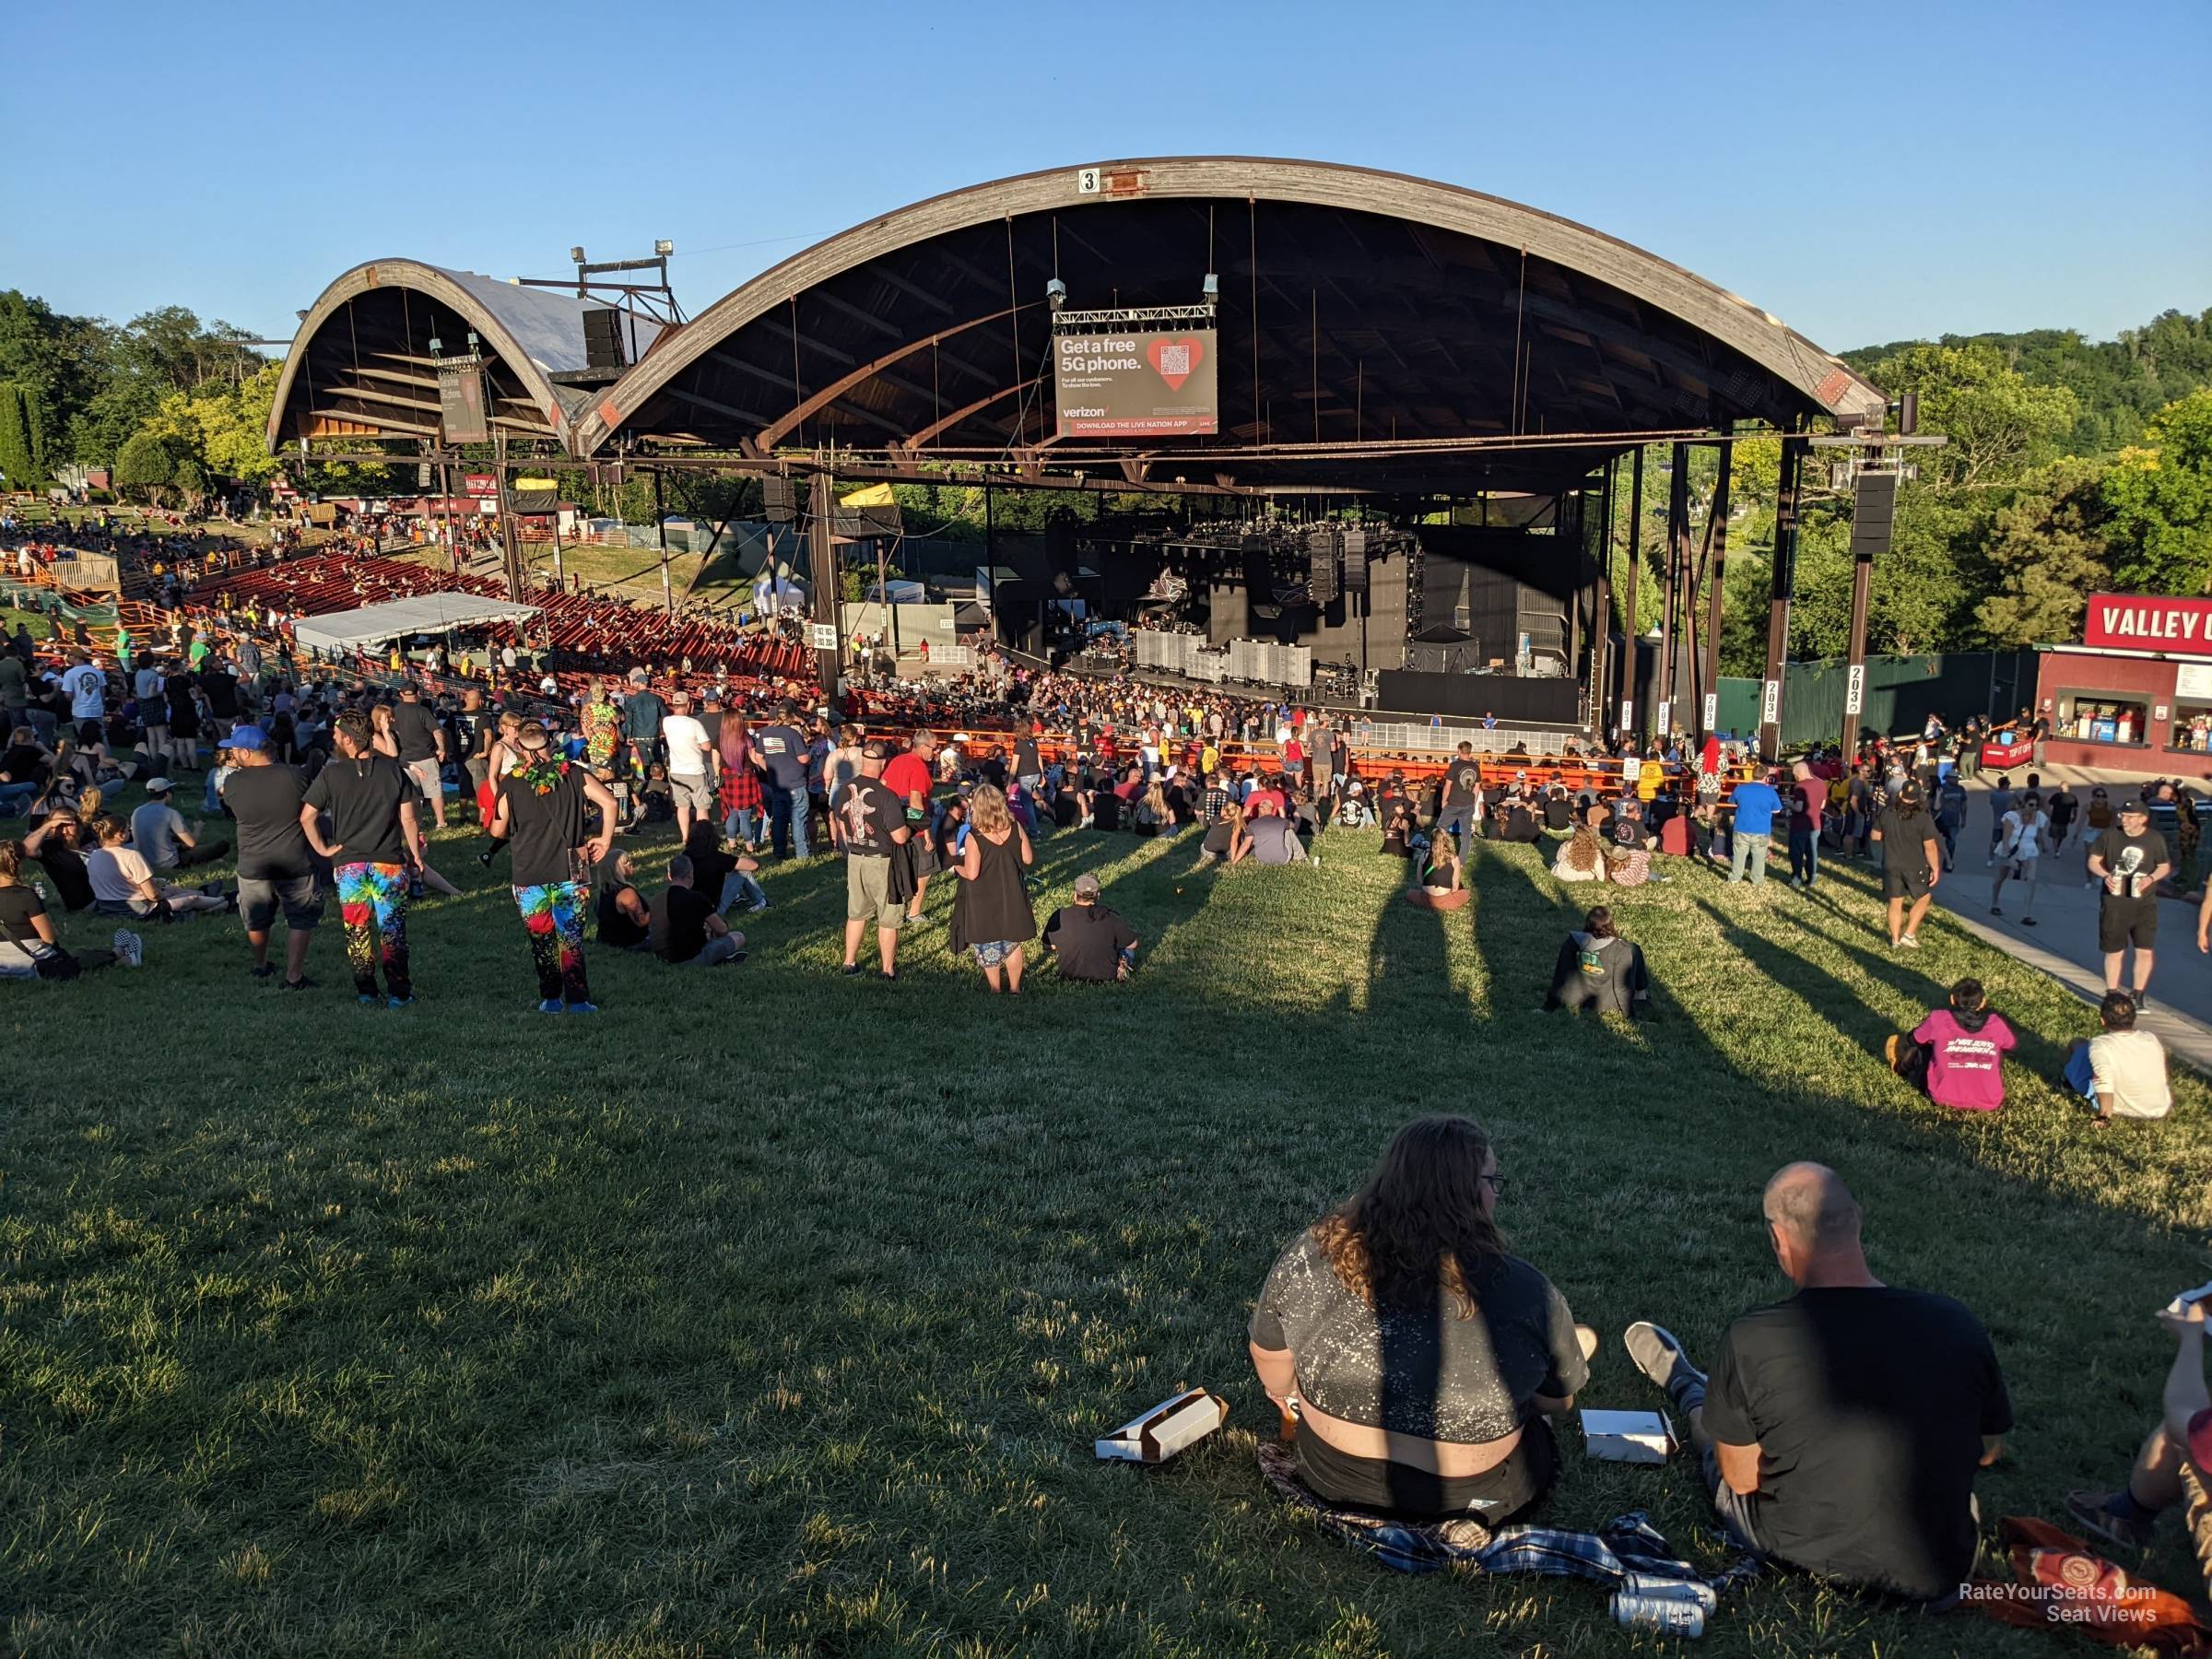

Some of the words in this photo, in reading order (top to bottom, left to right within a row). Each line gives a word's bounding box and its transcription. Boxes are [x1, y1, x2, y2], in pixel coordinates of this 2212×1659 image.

[1085, 172, 1094, 190] 3
[1061, 339, 1089, 354] Get
[1091, 342, 1101, 353] a
[1103, 338, 1135, 353] free
[1062, 357, 1085, 371] 5G
[1088, 356, 1141, 373] phone.
[1063, 406, 1104, 418] verizon
[2102, 607, 2200, 640] VALLEY
[1850, 667, 1861, 703] 203
[1768, 683, 1776, 712] 203
[2008, 747, 2018, 759] TOP
